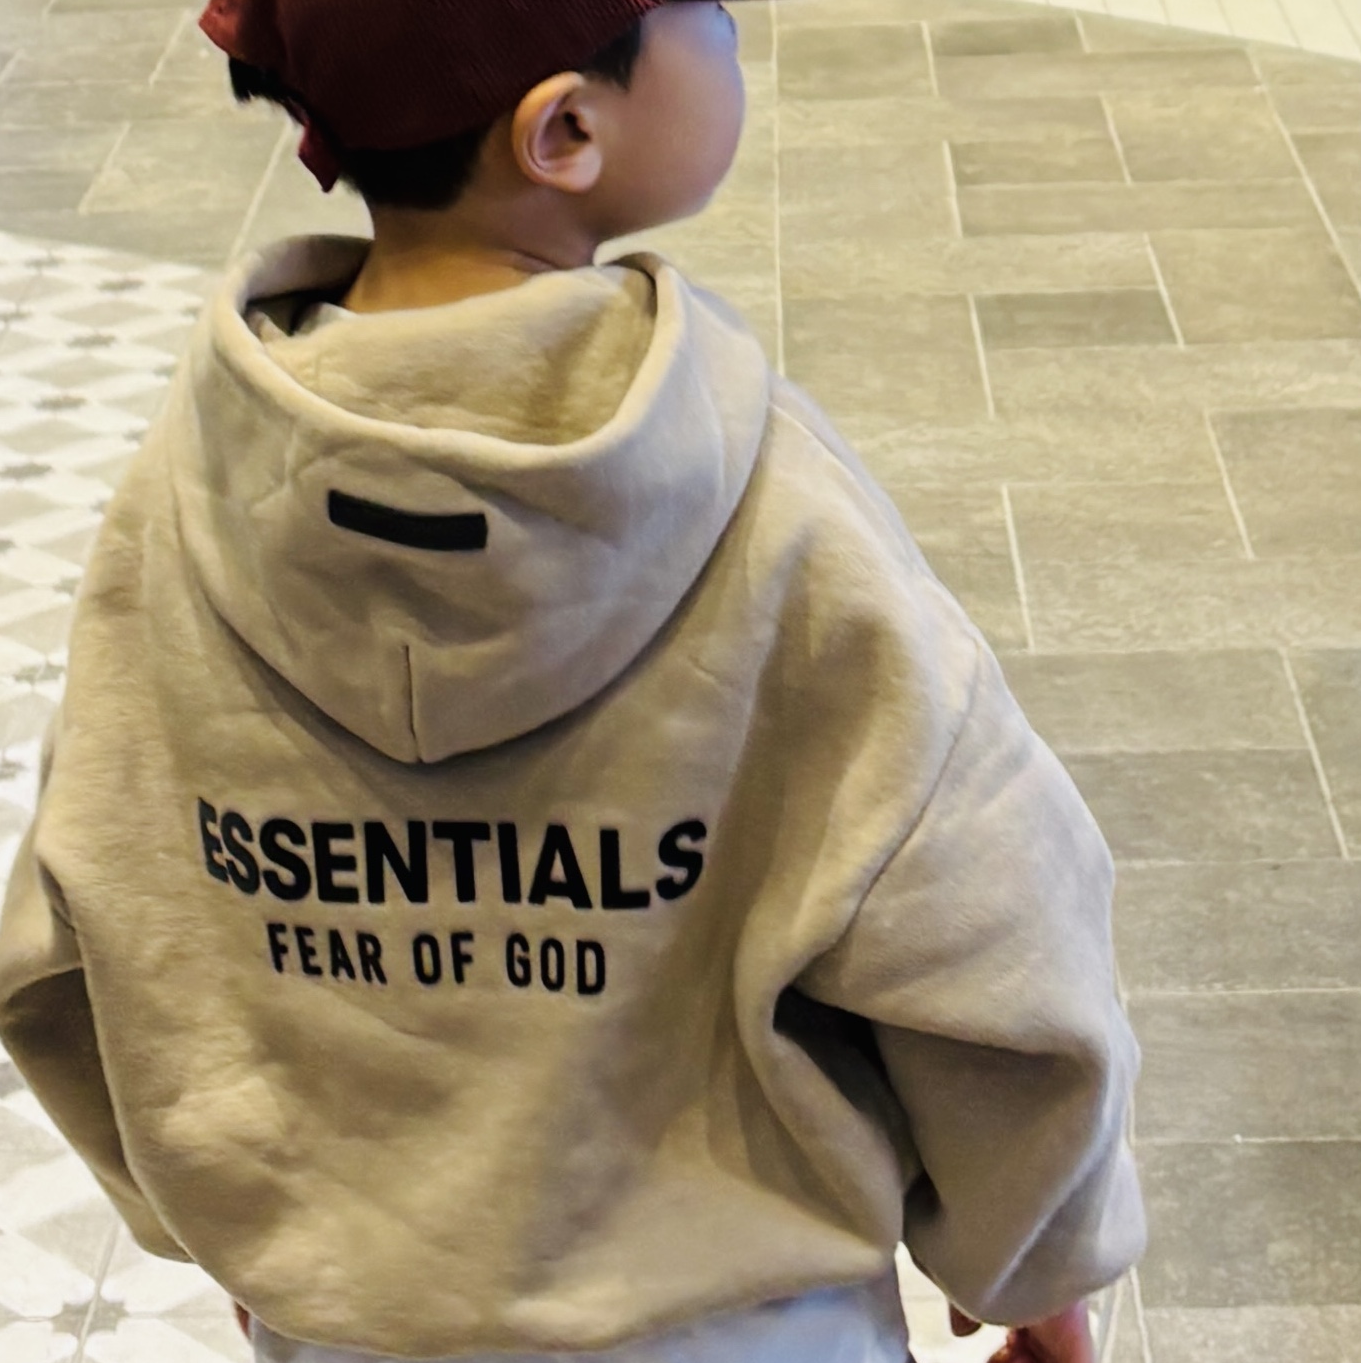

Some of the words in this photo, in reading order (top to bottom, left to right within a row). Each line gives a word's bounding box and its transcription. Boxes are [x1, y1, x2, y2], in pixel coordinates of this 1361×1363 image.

[197, 796, 708, 910] ESSENTIALS
[266, 922, 388, 986] FEAR
[412, 930, 474, 986] OF
[506, 934, 606, 996] GOD
